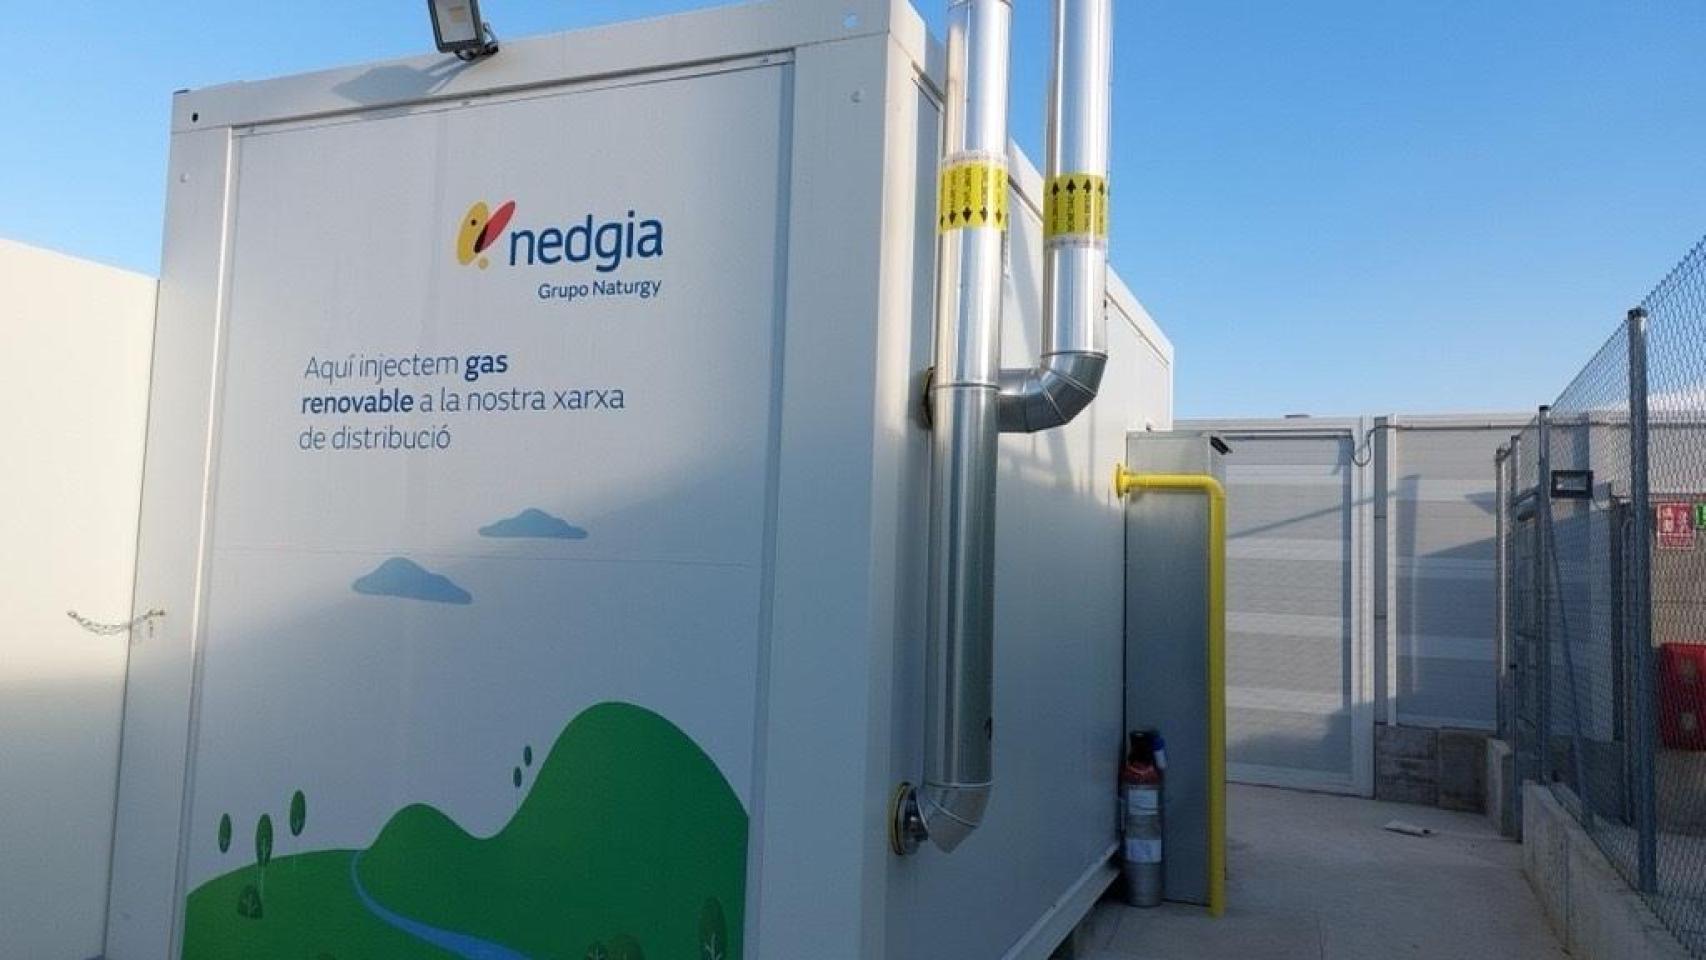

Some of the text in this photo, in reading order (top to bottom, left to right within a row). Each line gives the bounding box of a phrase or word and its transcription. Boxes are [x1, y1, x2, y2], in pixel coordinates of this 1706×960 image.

[509, 210, 664, 273] nedgia
[538, 279, 662, 302] Grupo Naturgy
[304, 353, 508, 385] Aquí injectem gas
[301, 387, 625, 414] renovable a la nostra xarxa
[300, 424, 451, 450] de distribució
